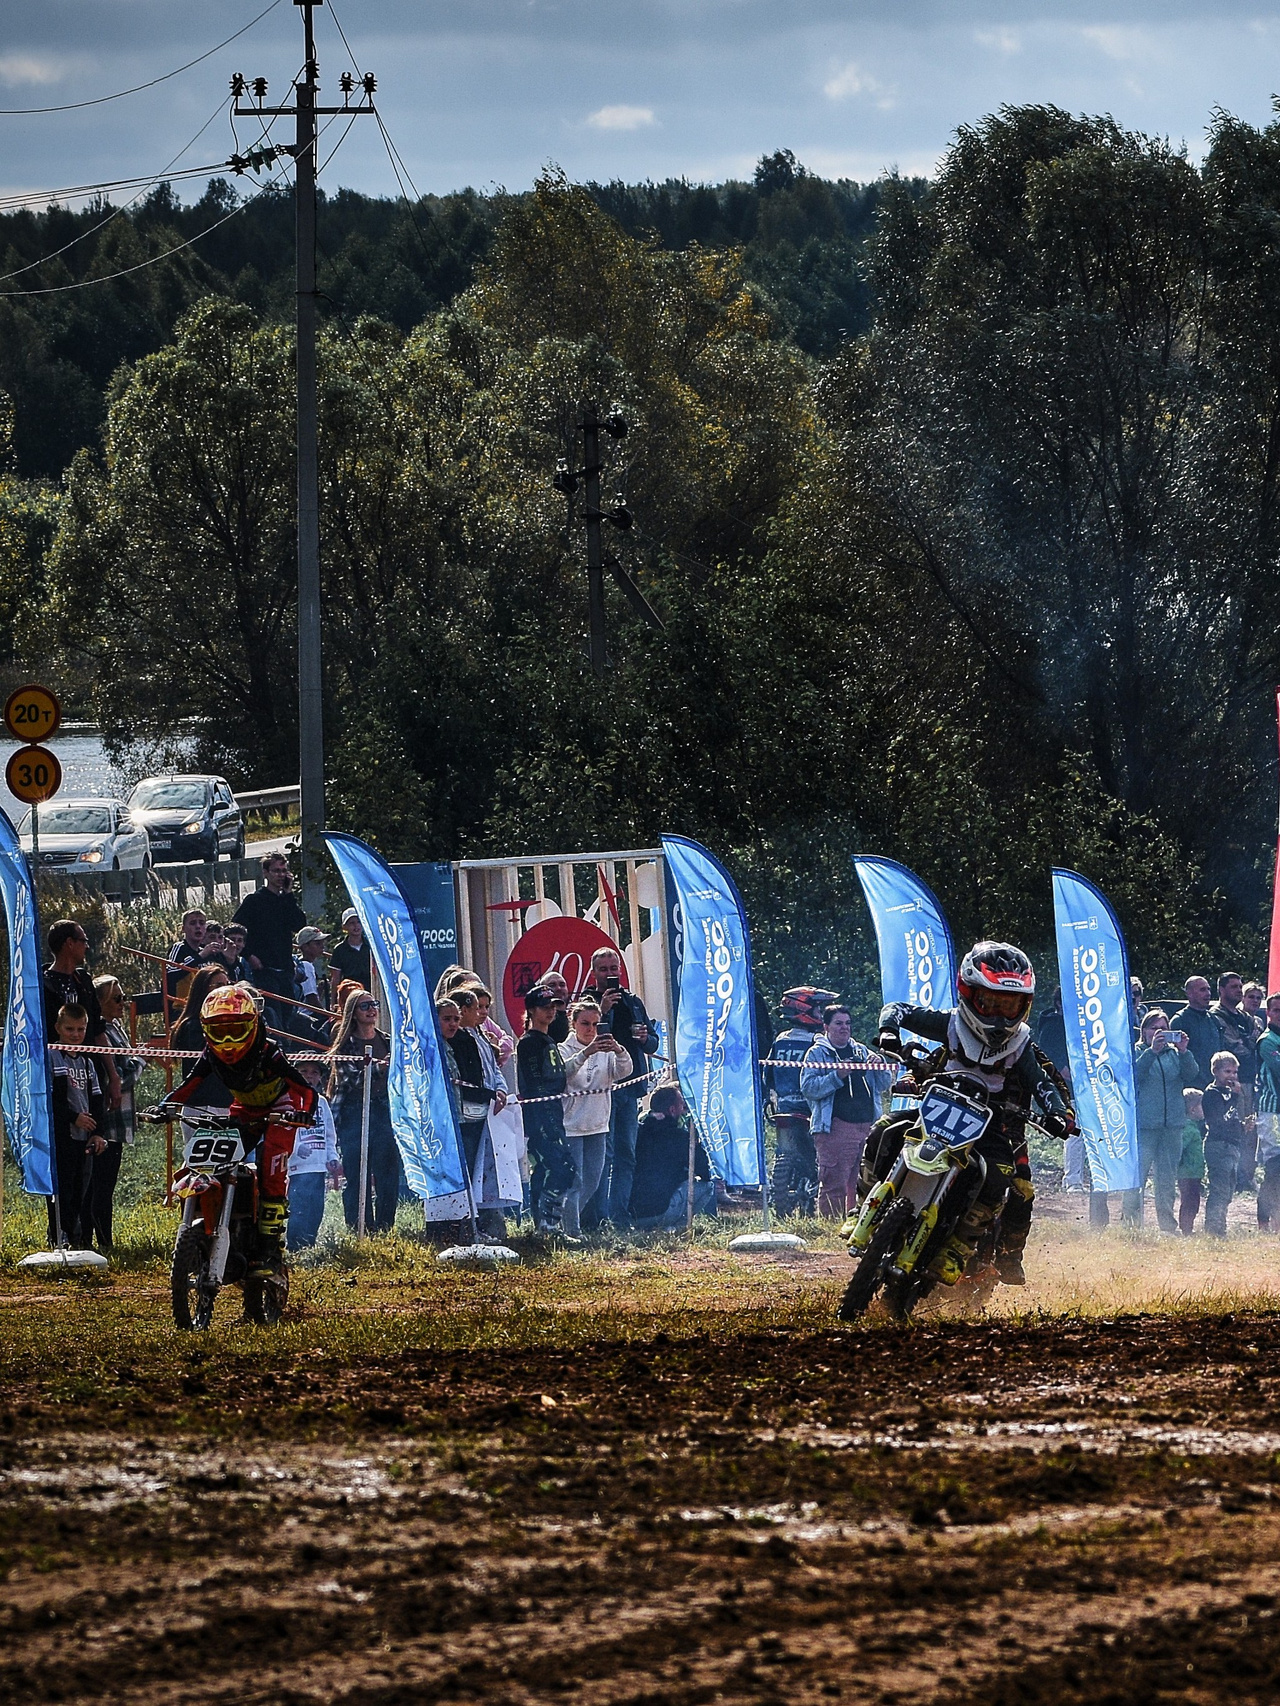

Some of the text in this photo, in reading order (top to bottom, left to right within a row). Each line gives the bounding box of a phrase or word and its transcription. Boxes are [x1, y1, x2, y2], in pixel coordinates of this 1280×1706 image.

[18, 764, 49, 787] 30
[924, 1098, 984, 1139] 717
[188, 1139, 238, 1163] 99
